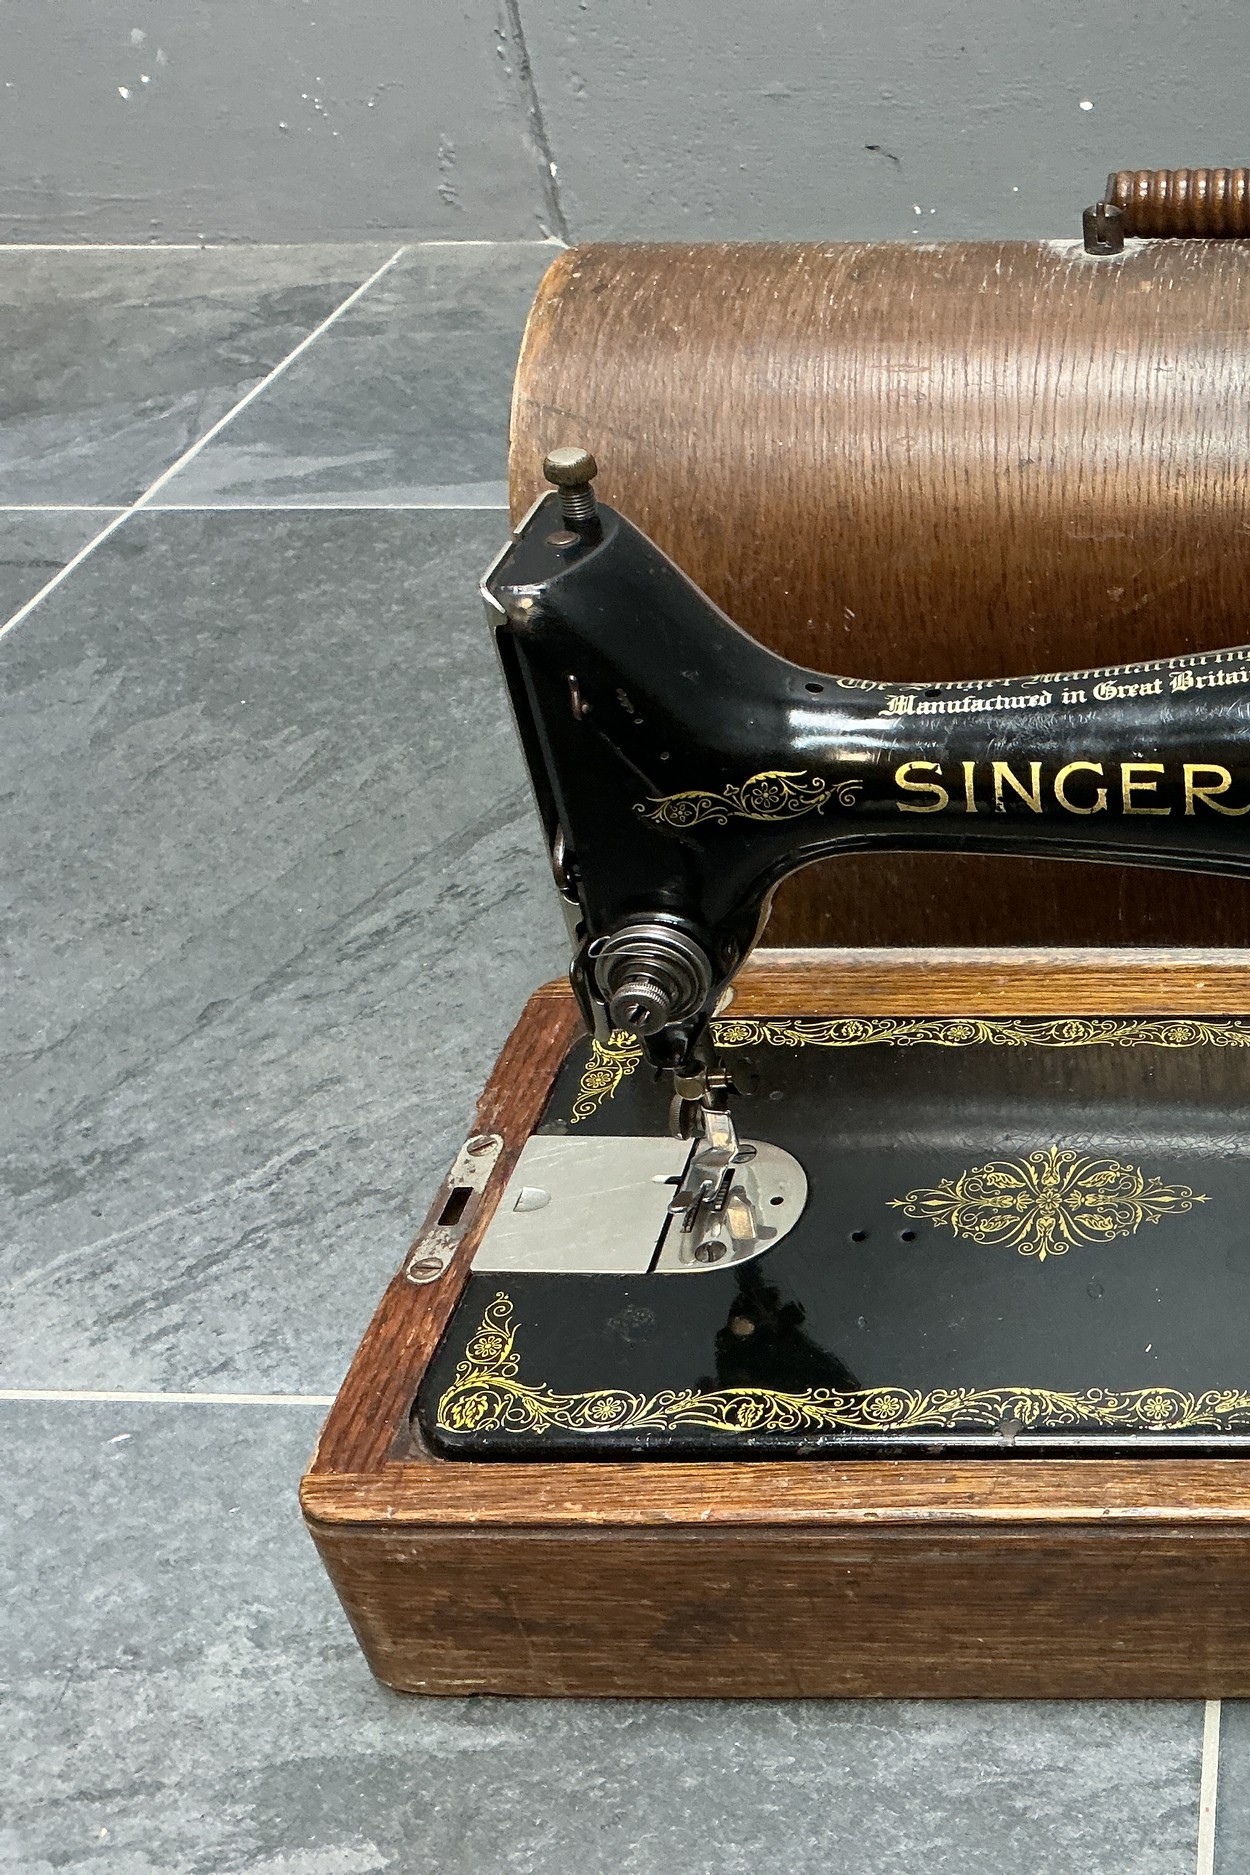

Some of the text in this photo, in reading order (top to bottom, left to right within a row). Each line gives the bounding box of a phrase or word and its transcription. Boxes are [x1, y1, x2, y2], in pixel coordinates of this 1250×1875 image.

[878, 690, 1053, 716] Manufactured
[1061, 687, 1087, 705] in
[1093, 677, 1163, 702] Great
[894, 760, 1250, 816] SINGER
